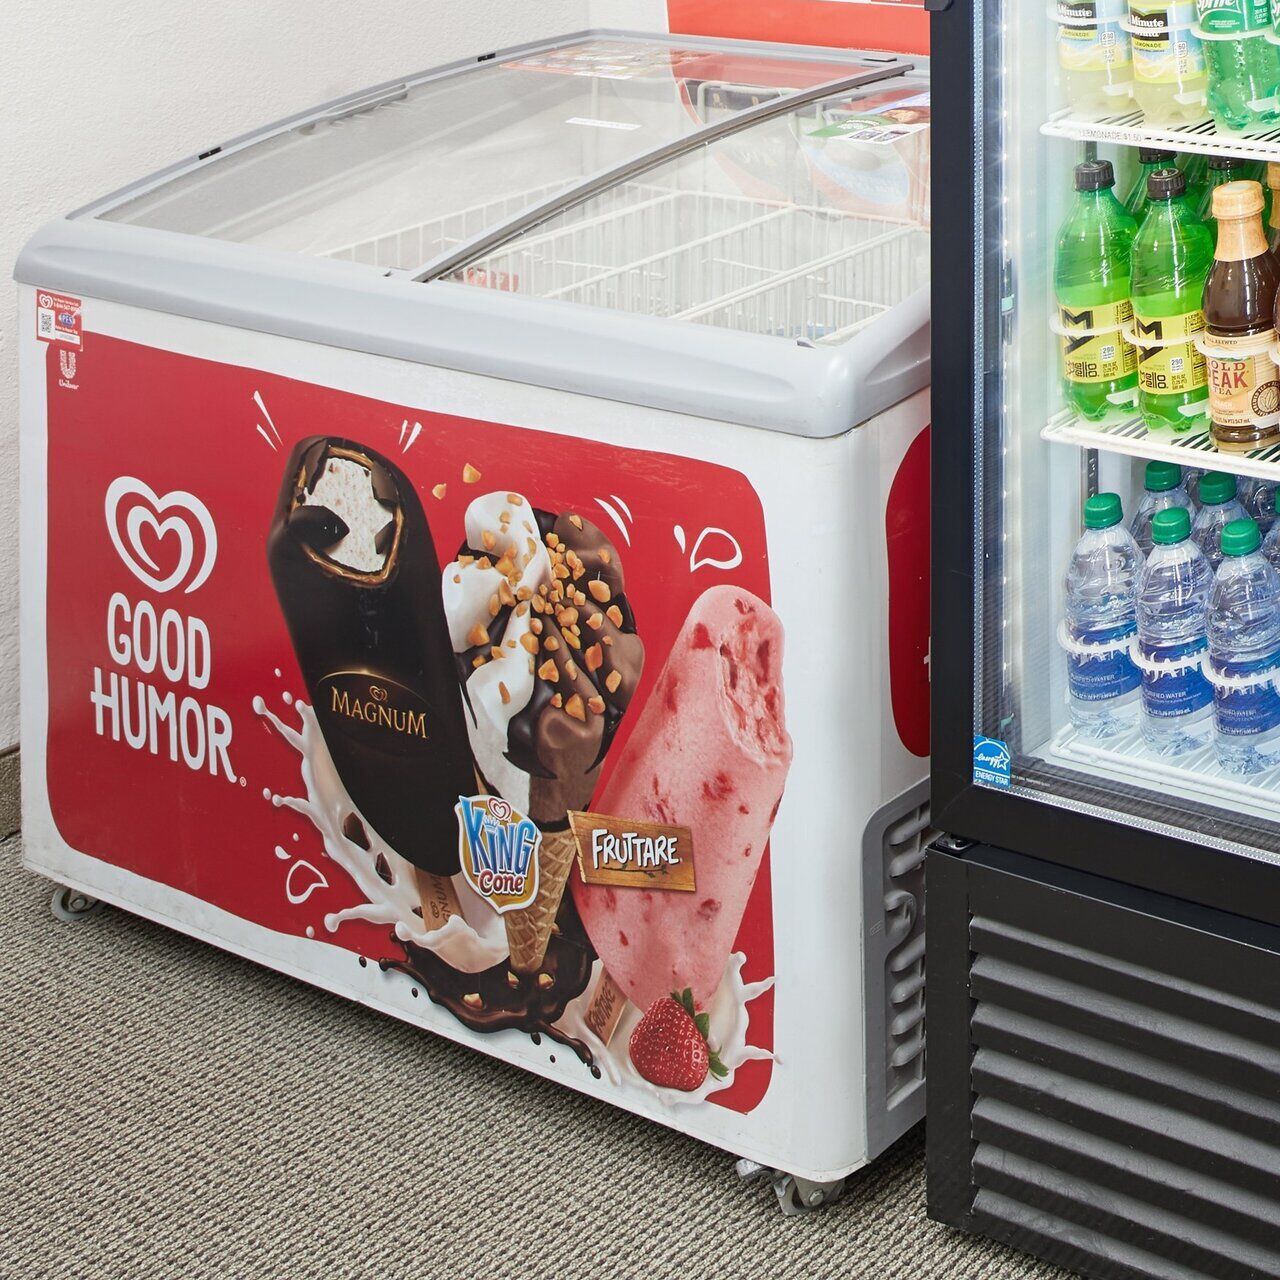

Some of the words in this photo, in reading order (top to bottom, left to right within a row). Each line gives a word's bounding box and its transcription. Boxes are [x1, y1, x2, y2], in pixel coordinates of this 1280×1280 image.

[1131, 15, 1164, 27] Minute
[107, 592, 211, 690] GOOD
[90, 667, 237, 788] HUMOR
[331, 687, 427, 738] MAGNUM
[976, 771, 995, 782] ENERGY
[996, 776, 1008, 785] STAR
[591, 829, 679, 869] FRUTTARE
[480, 869, 525, 894] Cone
